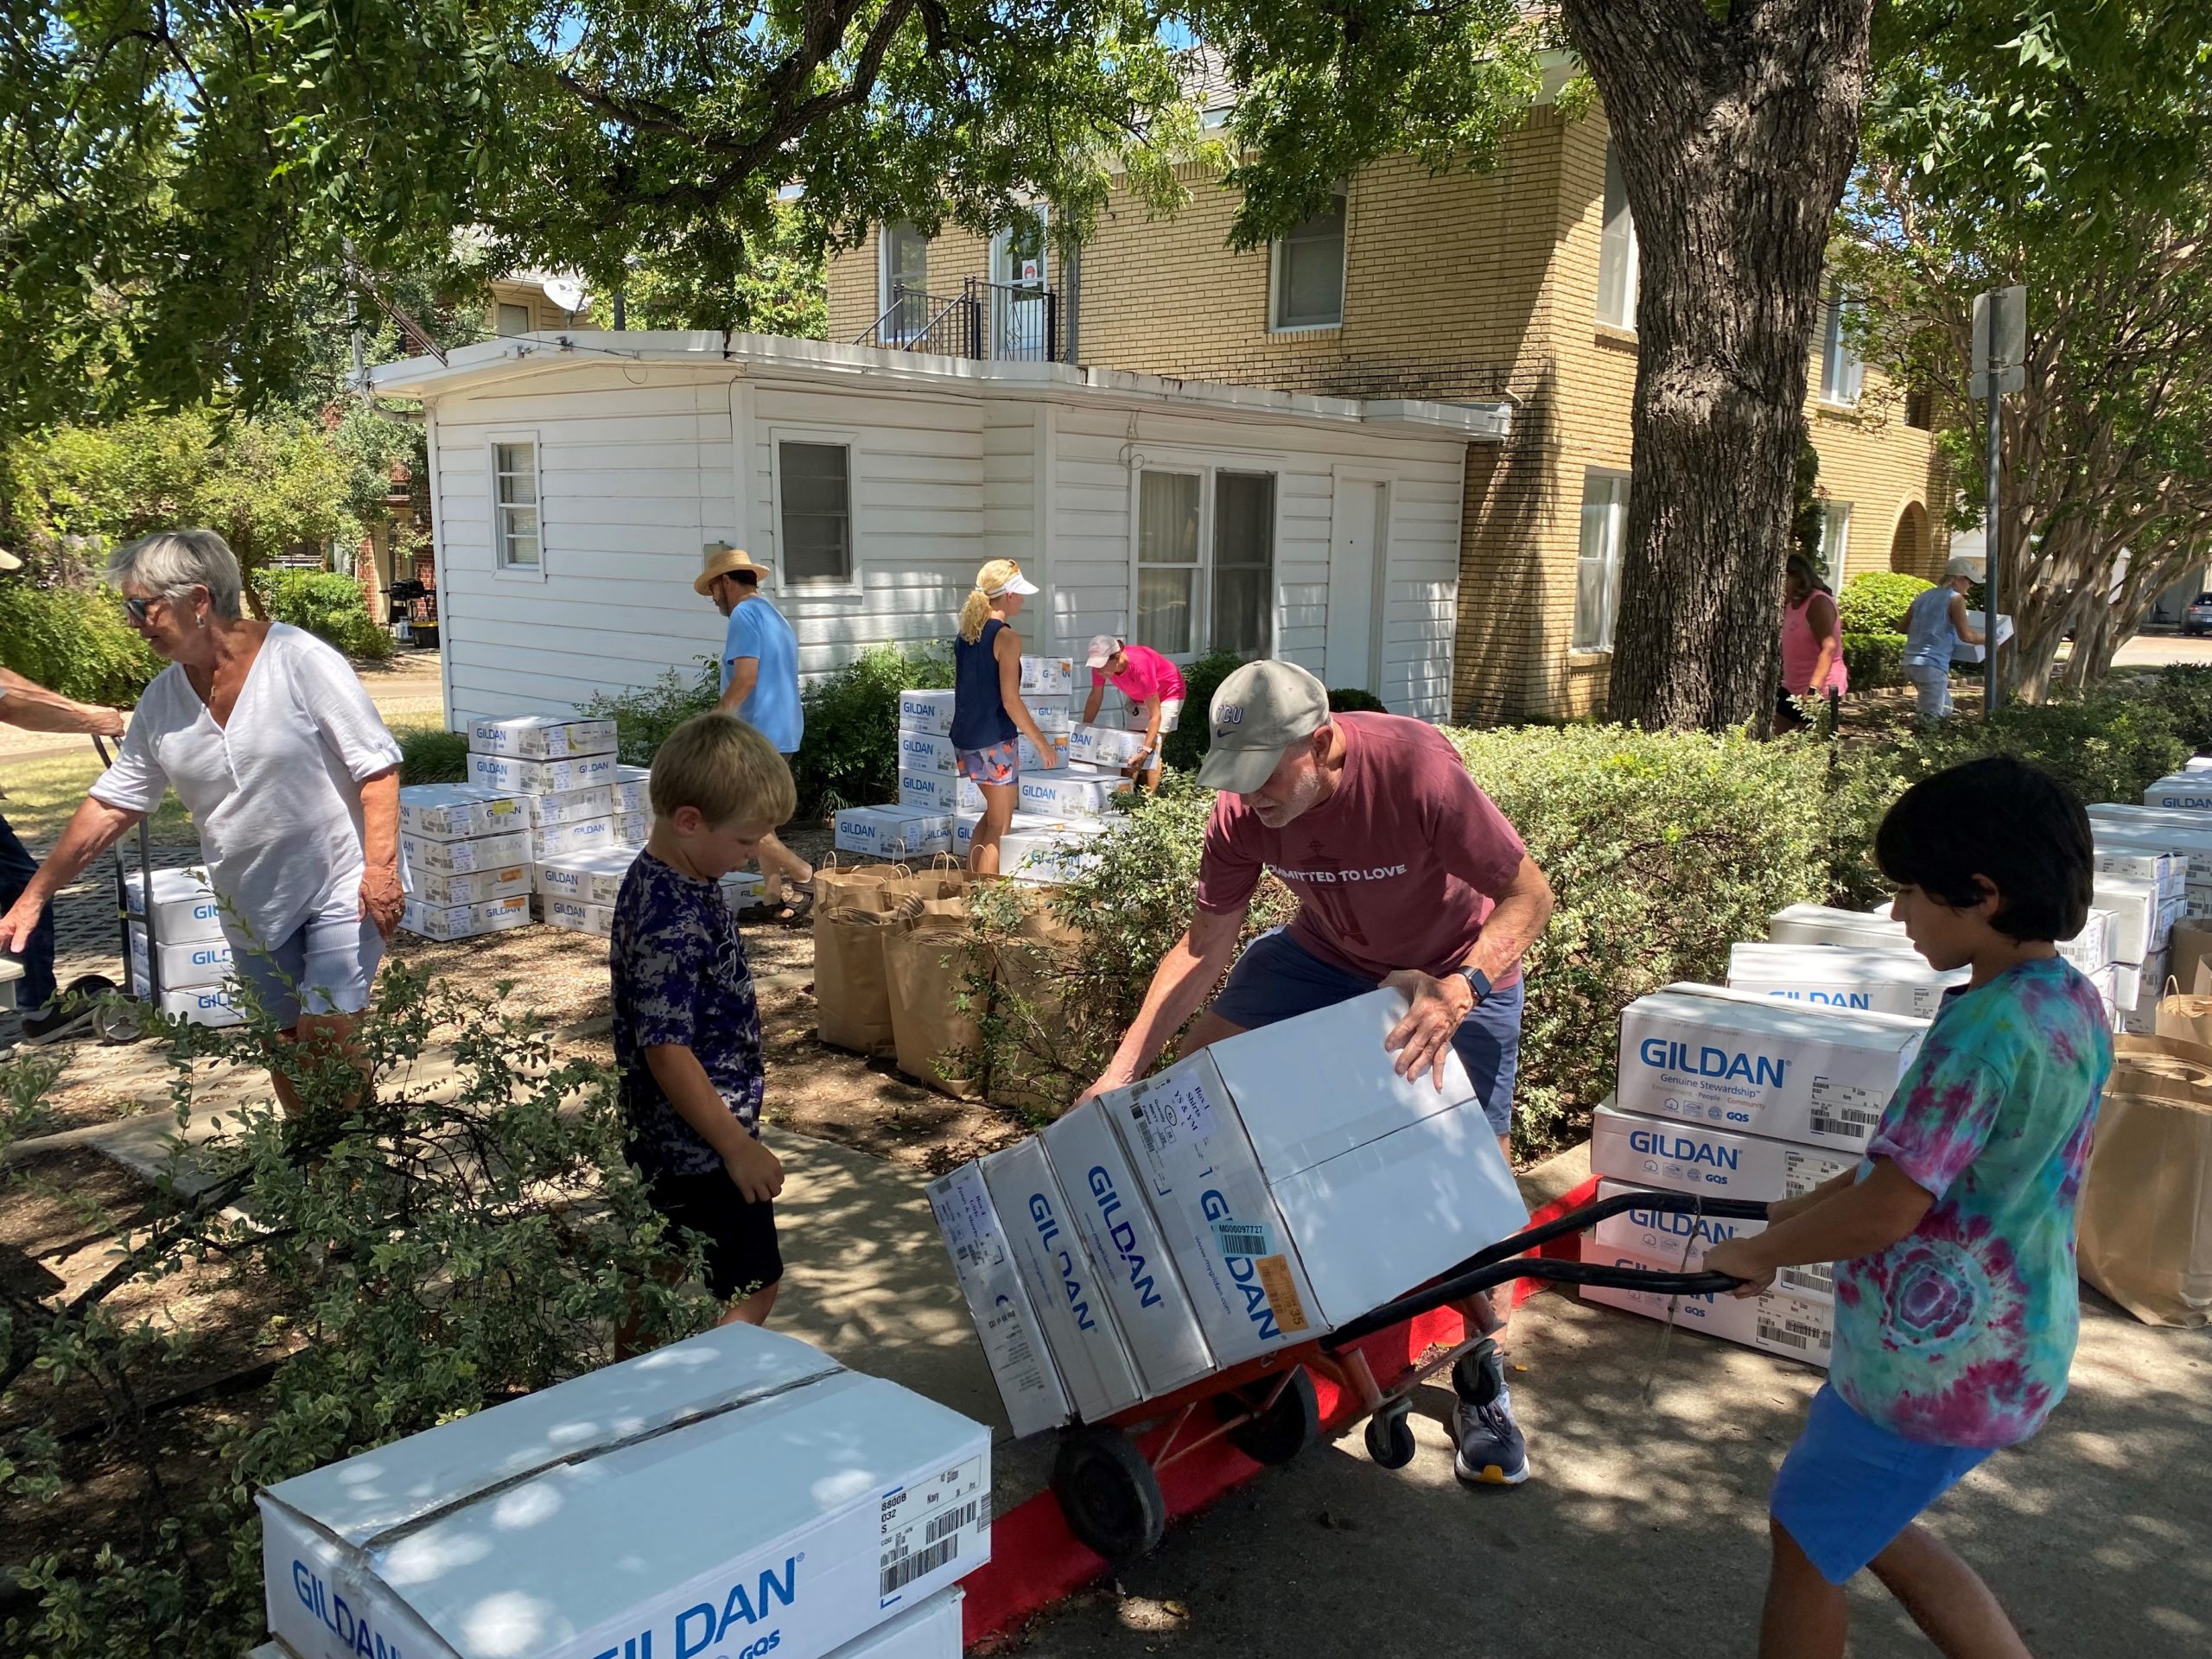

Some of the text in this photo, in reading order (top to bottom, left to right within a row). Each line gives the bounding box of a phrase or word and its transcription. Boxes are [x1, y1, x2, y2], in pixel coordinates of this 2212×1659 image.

[904, 702, 935, 716] GILDAN
[1217, 705, 1243, 724] TCU
[476, 728, 506, 741] GILDAN
[1071, 733, 1091, 746] DAN
[903, 740, 933, 755] GILDAN
[477, 761, 507, 775] GILDAN
[903, 778, 935, 792] GILDAN
[1022, 785, 1056, 800] GILDAN
[841, 822, 875, 838] GILDAN
[957, 827, 973, 839] GIL
[545, 870, 578, 886] GILDAN
[1267, 864, 1407, 882] OMMITTED TO LOVE
[194, 906, 219, 919] GIL
[553, 903, 585, 918] GILDAN
[192, 950, 231, 965] GIL
[1769, 991, 1869, 1010] DAN
[1640, 1039, 1784, 1088] GILDAN
[1661, 1073, 1756, 1098] Genuine Stewardship
[1194, 1086, 1205, 1103] Box
[1698, 1091, 1720, 1101] People
[1728, 1097, 1765, 1110] Community
[1181, 1105, 1188, 1114] &
[1186, 1092, 1200, 1117] Shirts
[1726, 1112, 1749, 1122] GQS
[1630, 1130, 1738, 1170] GILDAN
[1706, 1174, 1727, 1185] GQS
[1630, 1210, 1733, 1244] GILDAN
[1088, 1166, 1161, 1308] GILDAN
[1029, 1193, 1095, 1330] GILDAN
[1201, 1189, 1281, 1340] GDAN
[1685, 1306, 1706, 1318] GQS
[881, 1492, 906, 1511] 8800B
[881, 1509, 896, 1522] 032
[881, 1524, 887, 1533] S
[592, 1557, 795, 1659] DAN
[739, 1629, 780, 1659] GQS
